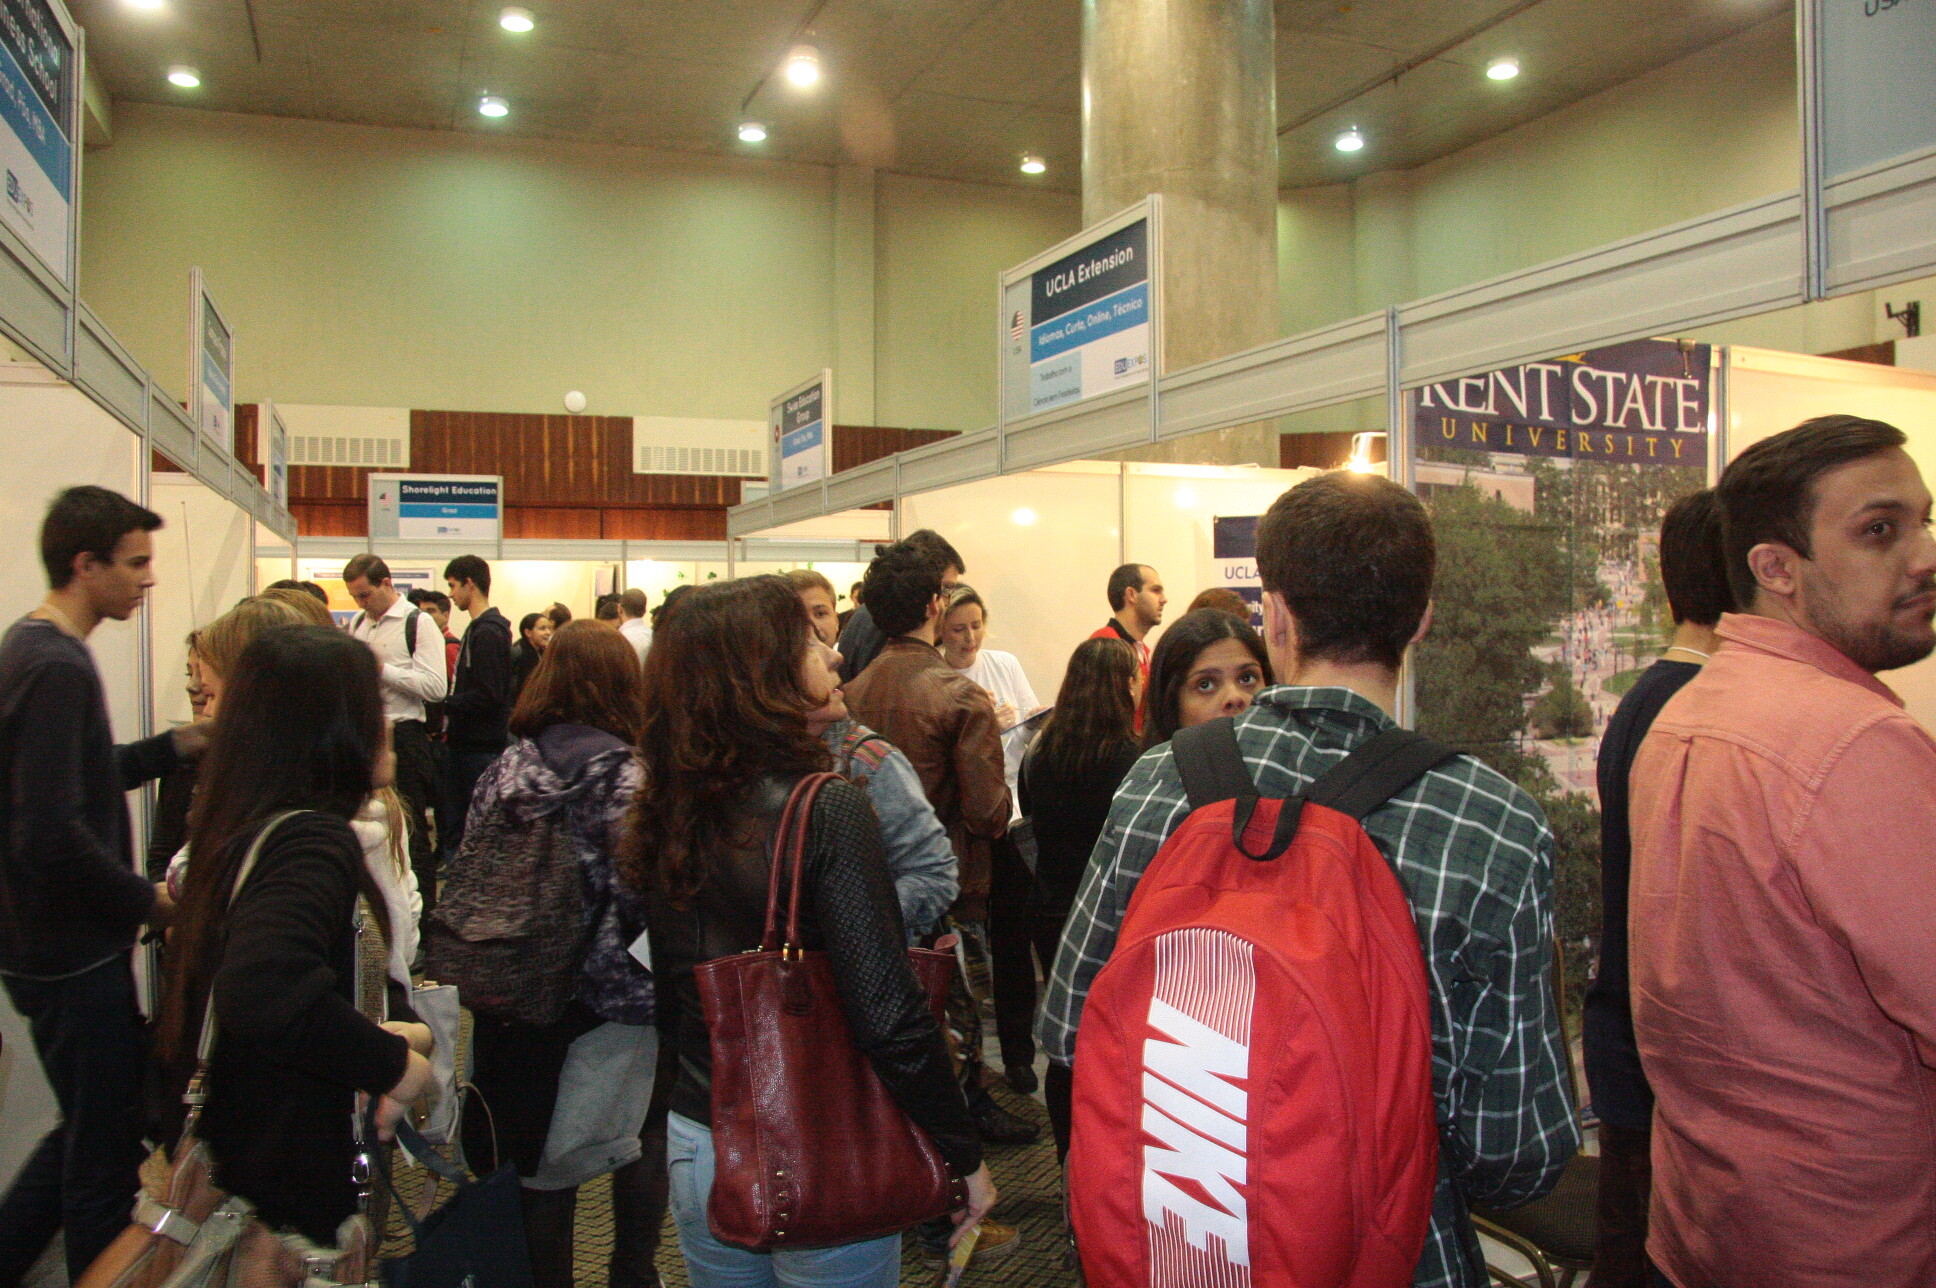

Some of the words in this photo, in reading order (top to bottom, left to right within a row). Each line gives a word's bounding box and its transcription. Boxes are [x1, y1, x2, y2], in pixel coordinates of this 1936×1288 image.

[0, 0, 26, 54] ness
[28, 36, 58, 105] School
[18, 0, 60, 69] national
[1046, 270, 1076, 297] UCLA
[1078, 247, 1134, 283] Extension
[1571, 367, 1701, 434] STATE
[1441, 417, 1684, 458] UNIVERSITY
[402, 485, 449, 496] Shorelight
[451, 485, 497, 495] Education
[1142, 996, 1250, 1267] NIKE
